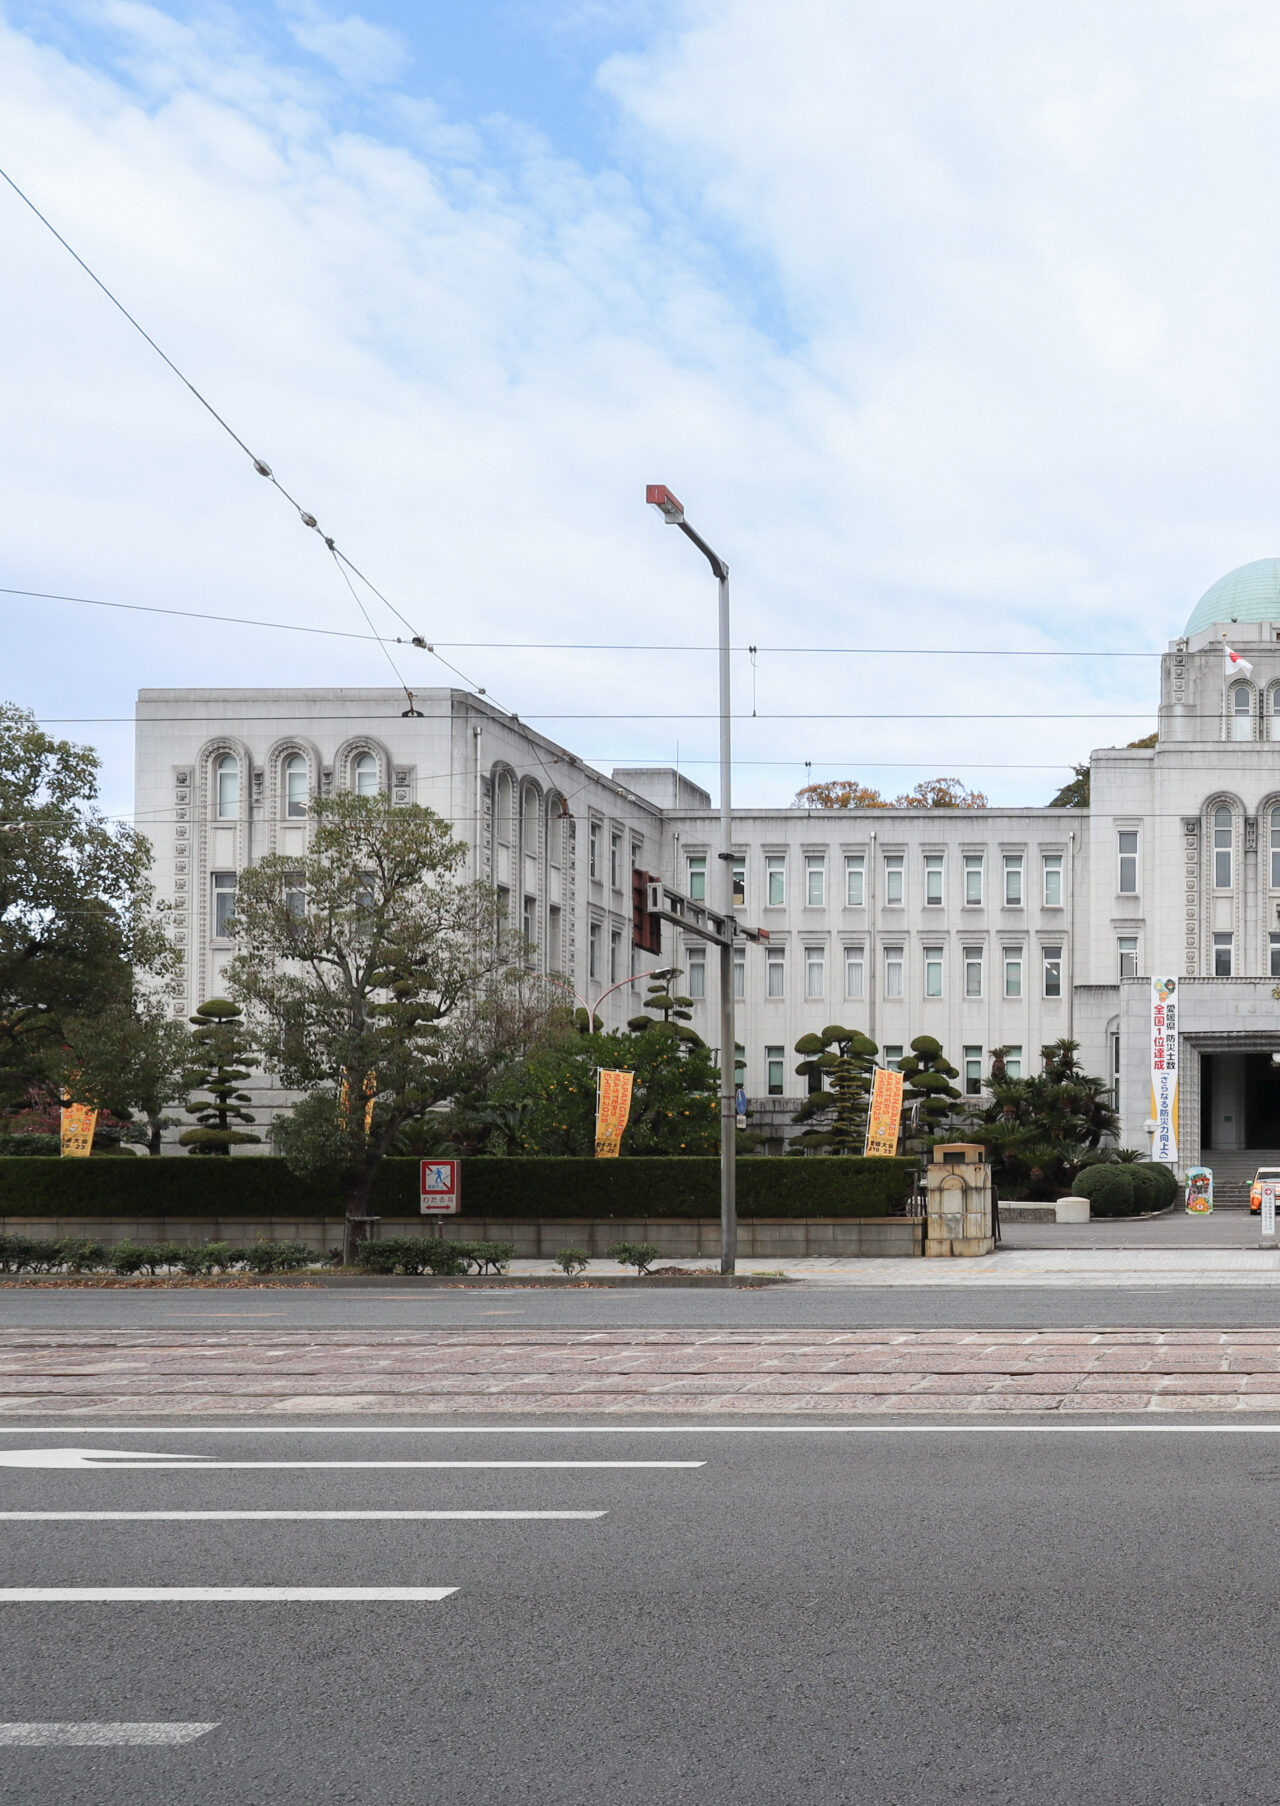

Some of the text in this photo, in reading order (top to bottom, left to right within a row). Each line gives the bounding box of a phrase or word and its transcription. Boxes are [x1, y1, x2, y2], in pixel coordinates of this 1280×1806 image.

[1153, 1004, 1165, 1070] 全国1位達成
[1166, 1004, 1176, 1070] 愛媛県 防災士数
[619, 1075, 629, 1106] JAPAN
[883, 1072, 894, 1116] MASTERS
[888, 1074, 901, 1137] JAPAN GAMES
[423, 1196, 454, 1204] わたるな
